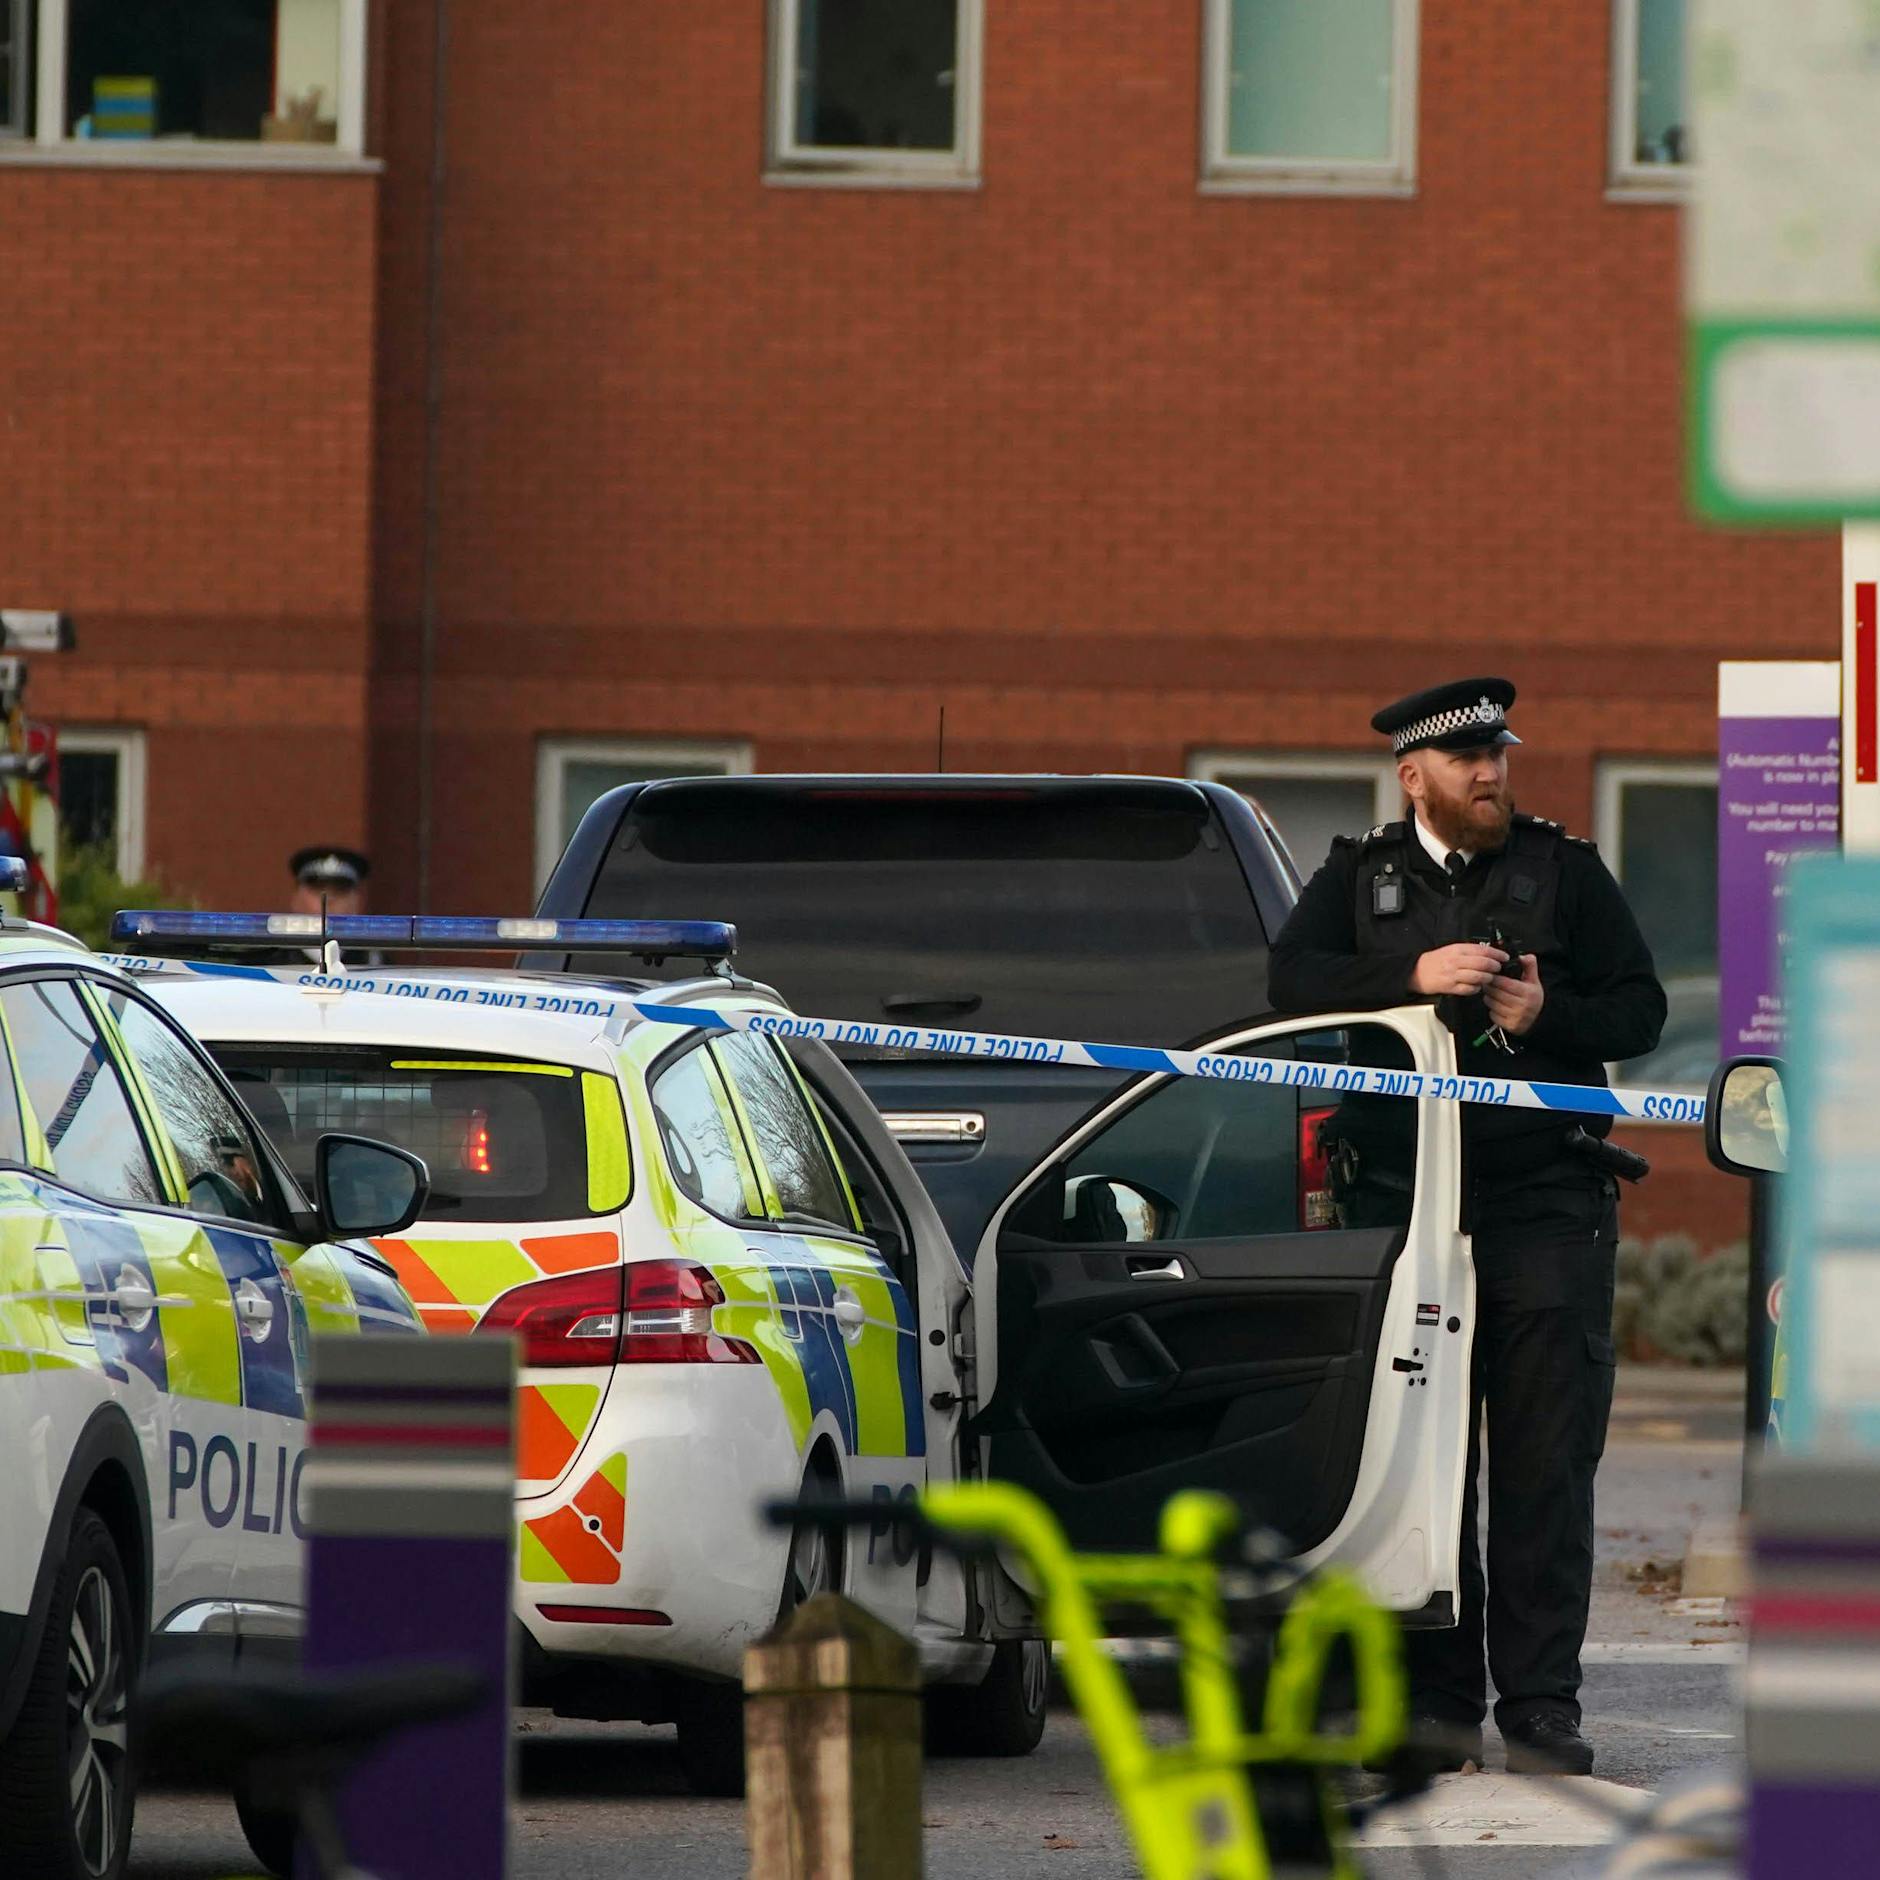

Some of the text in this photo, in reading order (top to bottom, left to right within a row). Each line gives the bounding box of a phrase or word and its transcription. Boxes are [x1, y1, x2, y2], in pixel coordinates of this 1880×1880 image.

[927, 1032, 978, 1055] LINE
[1281, 1063, 1327, 1088] NOT
[1372, 1071, 1426, 1097] LINE
